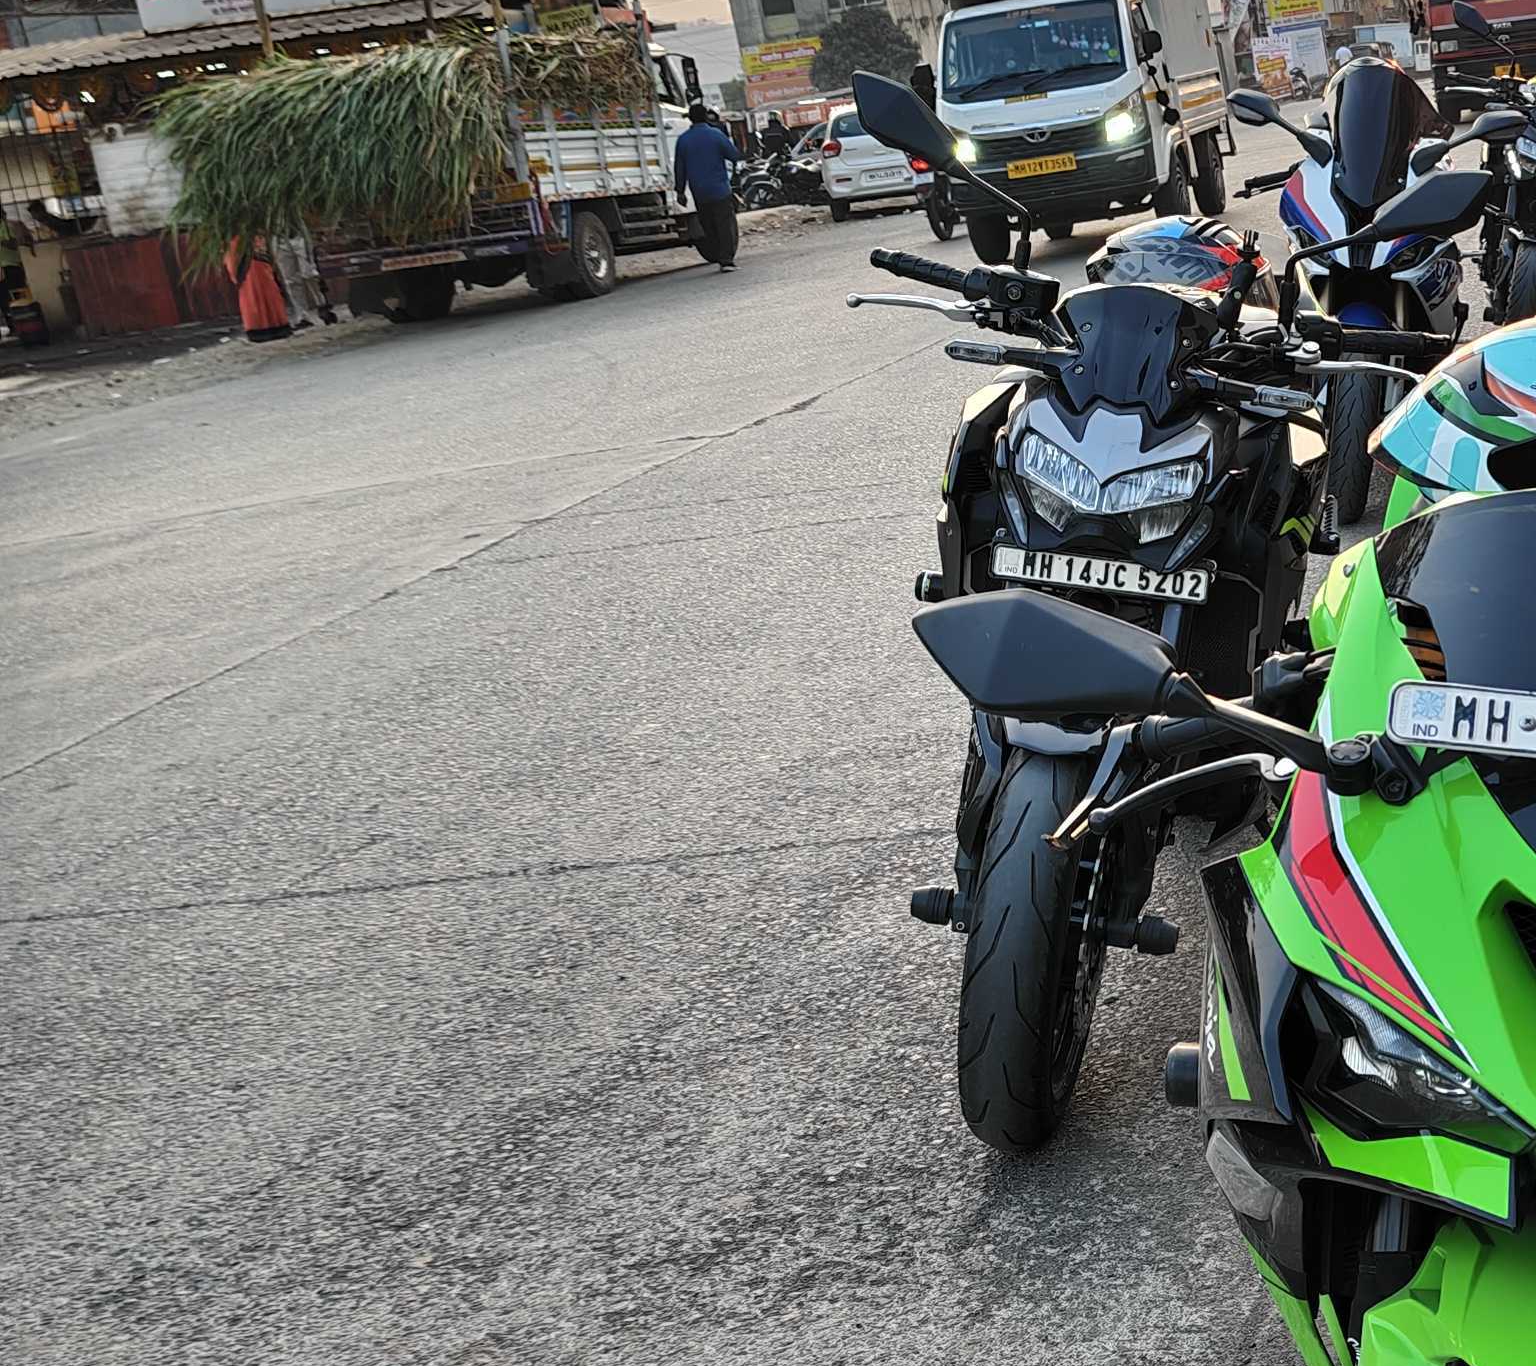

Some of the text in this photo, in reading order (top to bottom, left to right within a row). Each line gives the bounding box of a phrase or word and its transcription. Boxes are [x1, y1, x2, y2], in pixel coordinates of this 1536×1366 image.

[1004, 565, 1018, 575] IND
[1022, 549, 1203, 598] MH 14JC 5202
[1412, 722, 1439, 739] IND
[1452, 695, 1512, 744] MH
